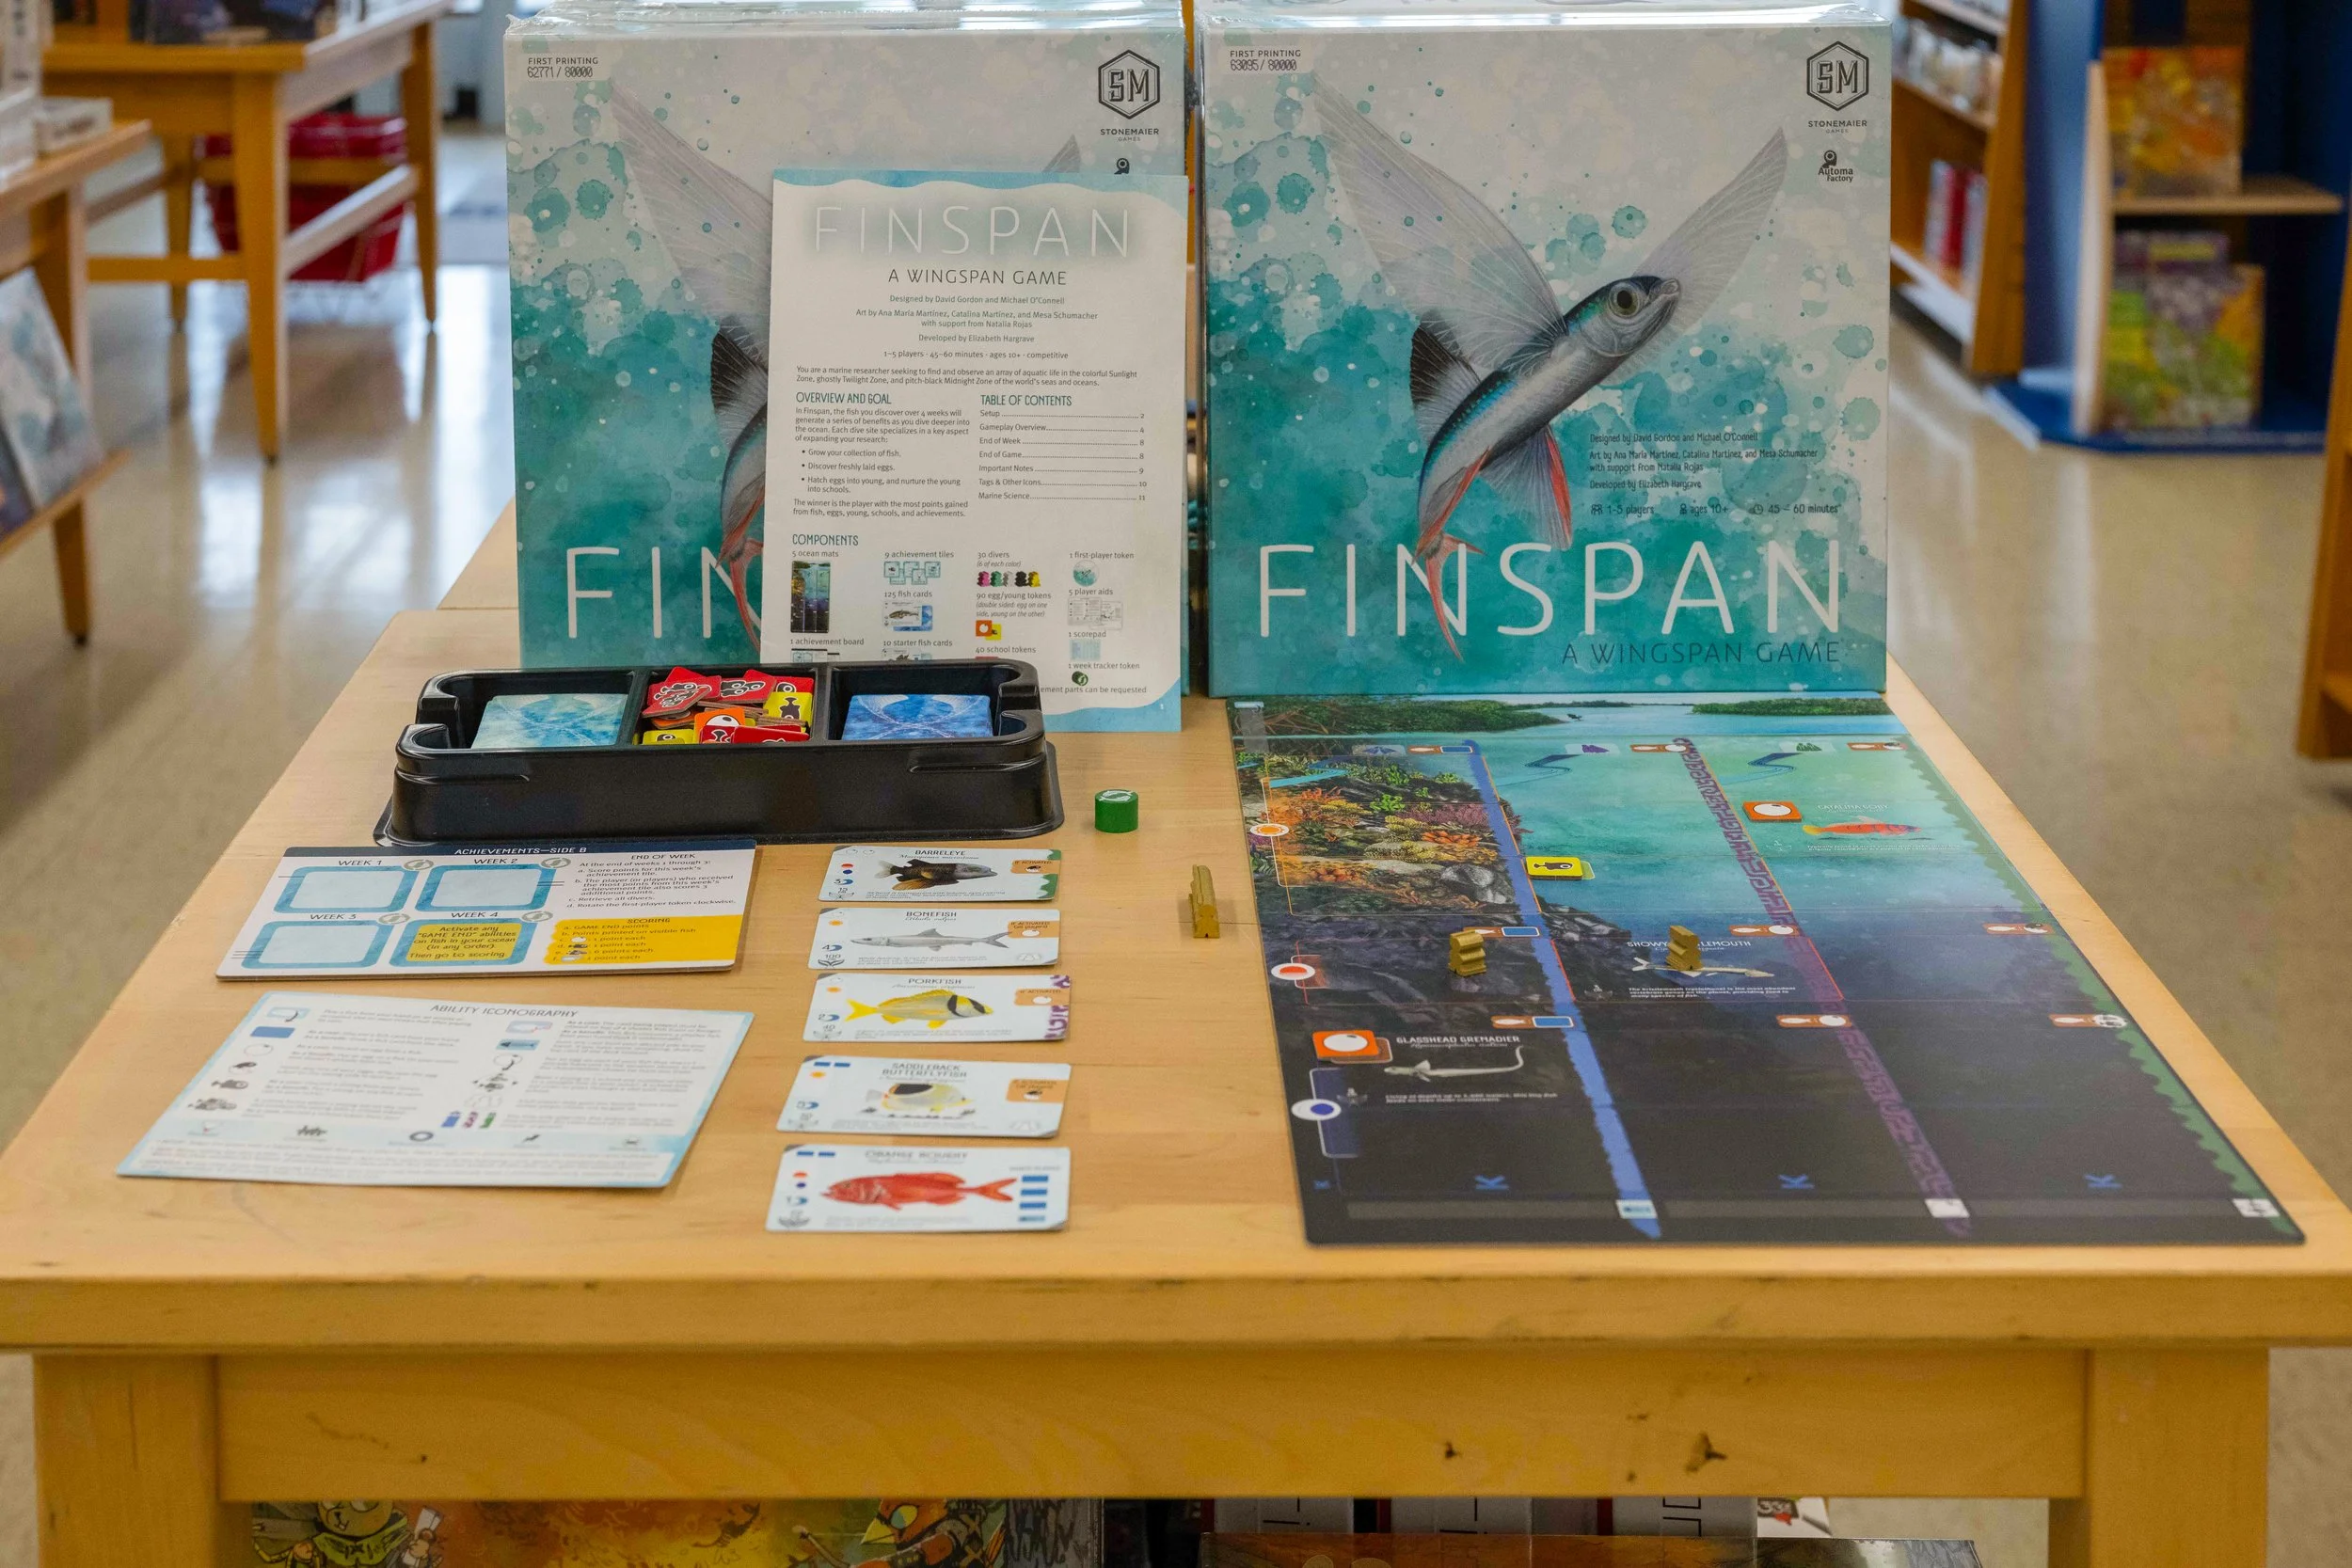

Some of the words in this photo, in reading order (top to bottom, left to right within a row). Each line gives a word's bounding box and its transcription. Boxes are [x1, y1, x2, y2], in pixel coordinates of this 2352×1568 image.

[527, 66, 553, 78] 62771
[557, 66, 561, 77] /
[564, 66, 593, 77] 80000
[1817, 60, 1858, 94] SM
[1108, 68, 1150, 103] SM
[815, 205, 1129, 257] FINSPAN
[888, 269, 898, 282] A
[907, 269, 1003, 283] WINGSPAN
[1013, 270, 1065, 285] GAME
[889, 294, 923, 303] Designed
[925, 295, 933, 304] by
[867, 309, 877, 317] by
[938, 320, 965, 328] support
[1012, 320, 1032, 328] Rojas
[918, 334, 956, 342] Developed
[958, 334, 966, 342] by
[1003, 335, 1034, 343] Hargrave
[898, 350, 924, 358] players
[796, 391, 844, 403] OVERVIEW
[847, 393, 866, 404] AND
[867, 393, 891, 404] GOAL
[980, 394, 1005, 405] TABLE
[1009, 394, 1022, 405] OF
[1025, 395, 1072, 406] CONTENTS
[980, 409, 999, 418] Setup
[979, 422, 1013, 432] Gameplay
[1590, 435, 1620, 445] Designed
[1623, 434, 1631, 445] by
[1634, 434, 1651, 442] David
[1655, 434, 1679, 442] Gordon
[1697, 433, 1722, 441] Michael
[978, 465, 1011, 473] Important
[978, 478, 993, 486] Tags
[1590, 481, 1625, 491] Developed
[1628, 481, 1635, 491] by
[1672, 481, 1701, 491] Hargrave
[1608, 505, 1623, 514] 1-5
[1626, 504, 1654, 517] players
[1690, 506, 1707, 517] ages
[1712, 504, 1727, 514] 10+
[1768, 504, 1780, 514] 45
[1794, 504, 1805, 514] 60
[1808, 504, 1838, 514] minutes
[792, 534, 858, 546] COMPONENTS
[1261, 540, 1839, 638] FINSPAN
[1562, 643, 1578, 664] A
[1590, 641, 1743, 664] WINGSPAN
[1756, 641, 1840, 664] GAME
[1064, 685, 1084, 693] parts
[430, 1005, 479, 1013] ABILITY
[483, 1008, 577, 1017] ICONOGRAPHY
